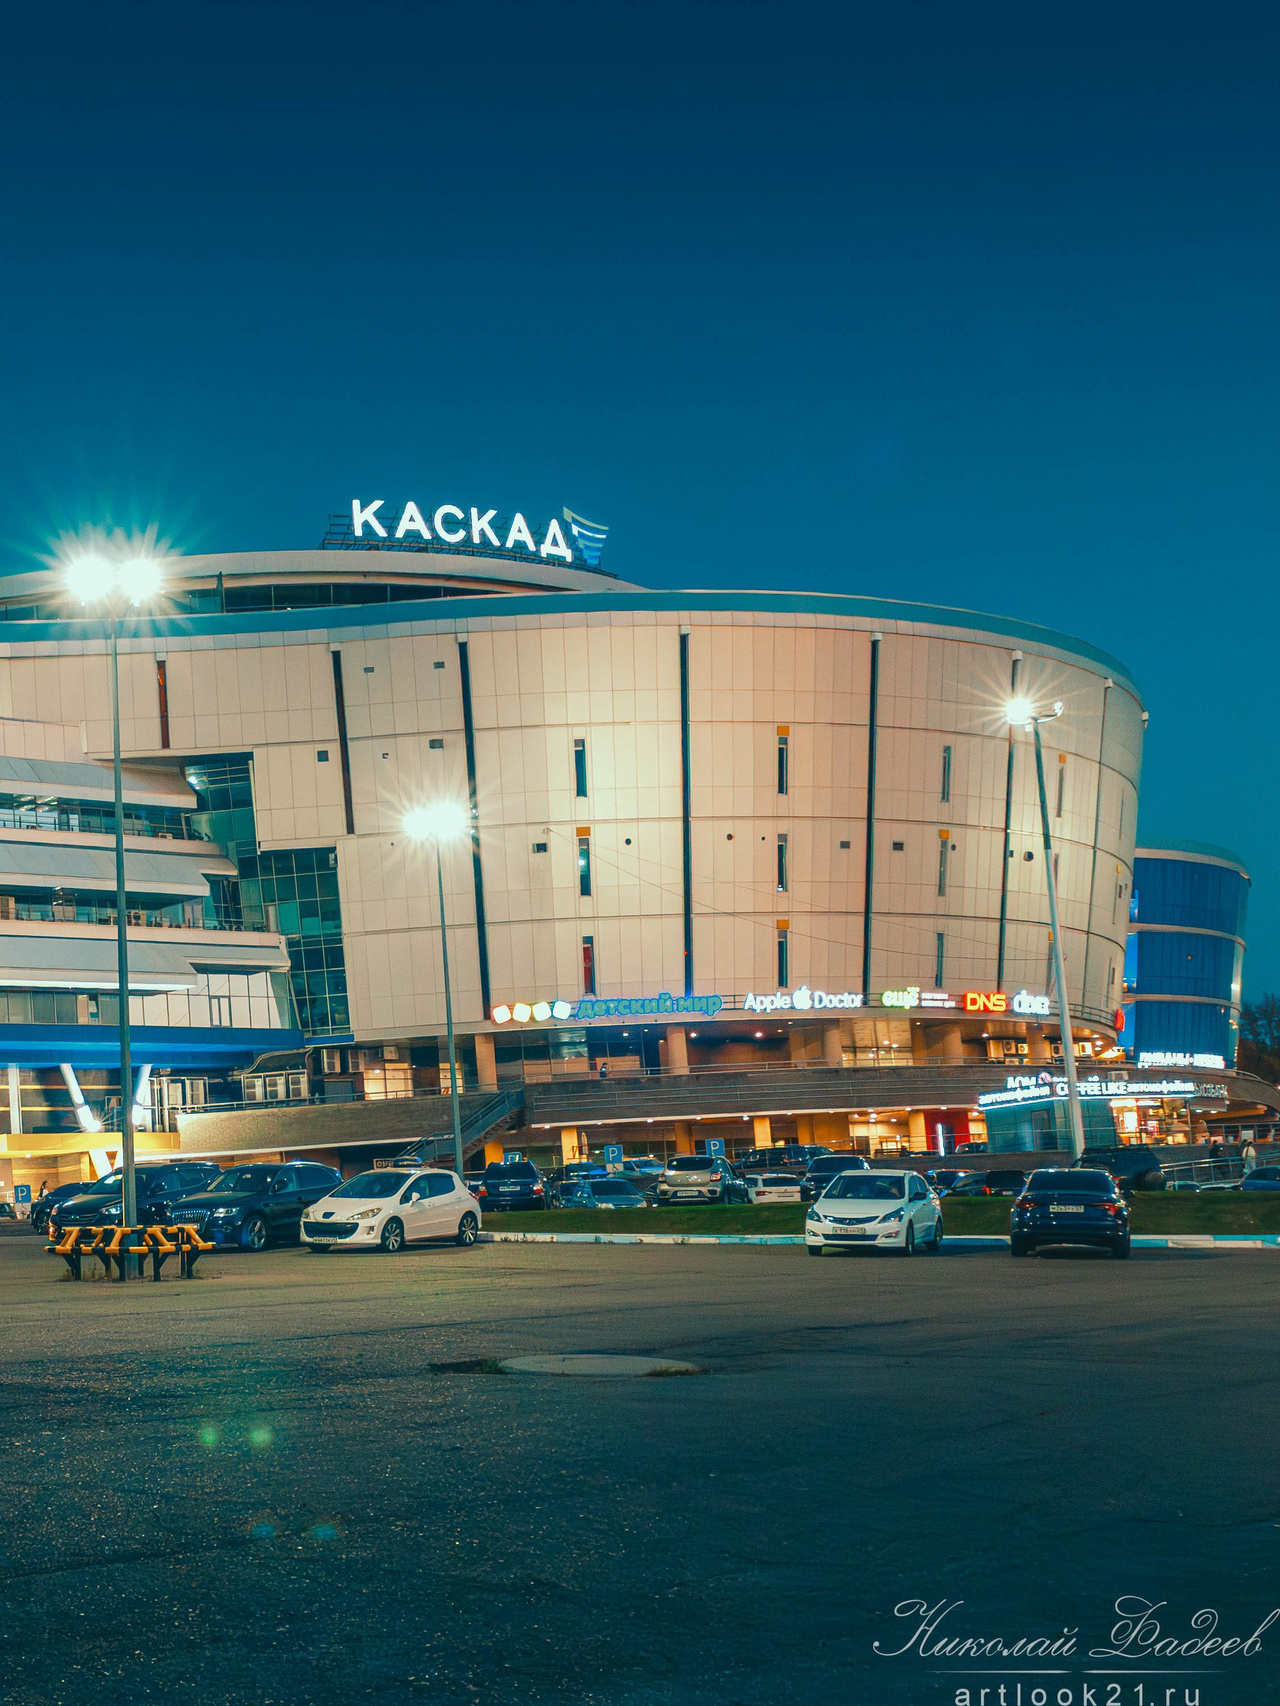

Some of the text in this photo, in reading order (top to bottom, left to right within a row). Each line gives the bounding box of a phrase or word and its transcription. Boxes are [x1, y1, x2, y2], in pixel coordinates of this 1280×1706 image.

[352, 499, 572, 562] КАСКАД
[576, 992, 723, 1020] детский мир
[744, 991, 863, 1013] Apple Doctor
[966, 992, 1007, 1012] DNS
[1102, 1081, 1127, 1095] LIKE
